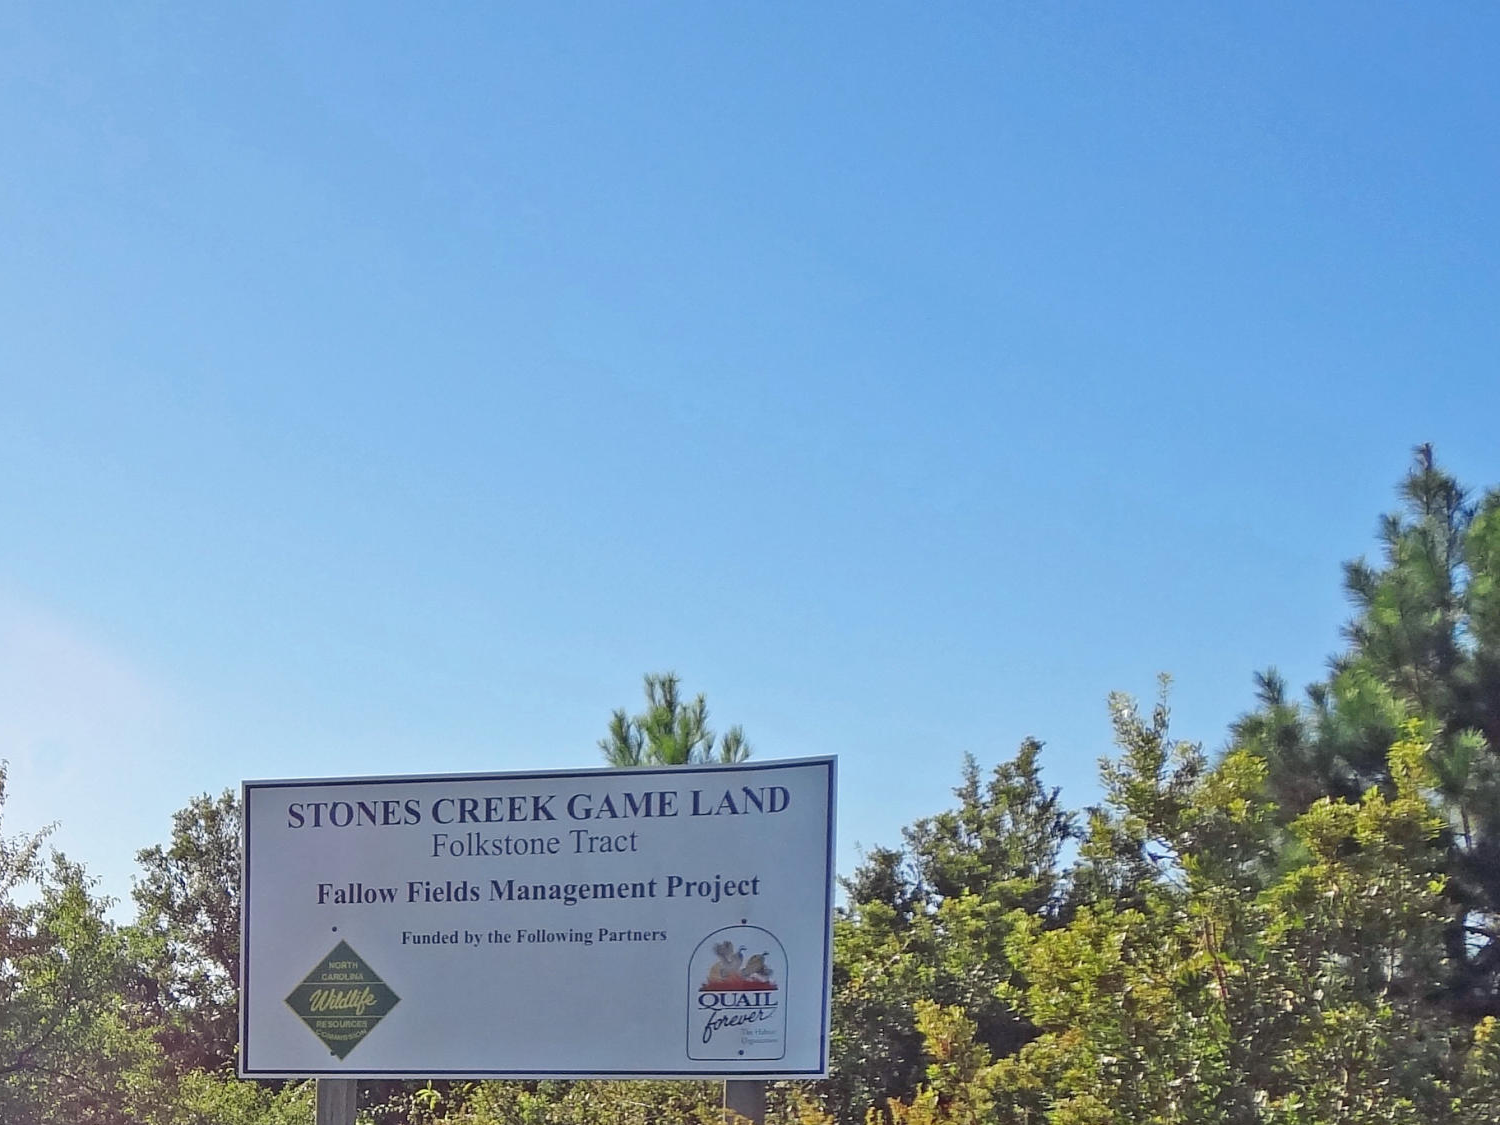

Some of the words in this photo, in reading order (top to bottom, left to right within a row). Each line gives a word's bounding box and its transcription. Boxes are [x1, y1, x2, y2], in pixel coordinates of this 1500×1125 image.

[287, 799, 422, 829] STONES
[431, 795, 558, 825] CREEK
[566, 790, 679, 820] GAME
[689, 786, 791, 817] LAND
[431, 832, 561, 858] Folkstone
[569, 829, 639, 854] Tract
[317, 882, 398, 905] Fallow
[406, 880, 480, 903] Fields
[489, 877, 658, 906] Management
[666, 874, 761, 903] Project
[401, 930, 459, 945] Funded
[464, 931, 483, 947] by
[487, 930, 512, 944] the
[517, 928, 594, 946] Following
[598, 927, 668, 942] Partners
[328, 961, 359, 970] NORTH
[321, 973, 364, 981] CAROLINA
[309, 986, 378, 1016] Wildlife
[698, 992, 778, 1011] QUAIL
[315, 1020, 368, 1029] RESOURCES
[702, 1009, 775, 1044] forever
[315, 1029, 368, 1041] COMMISSION
